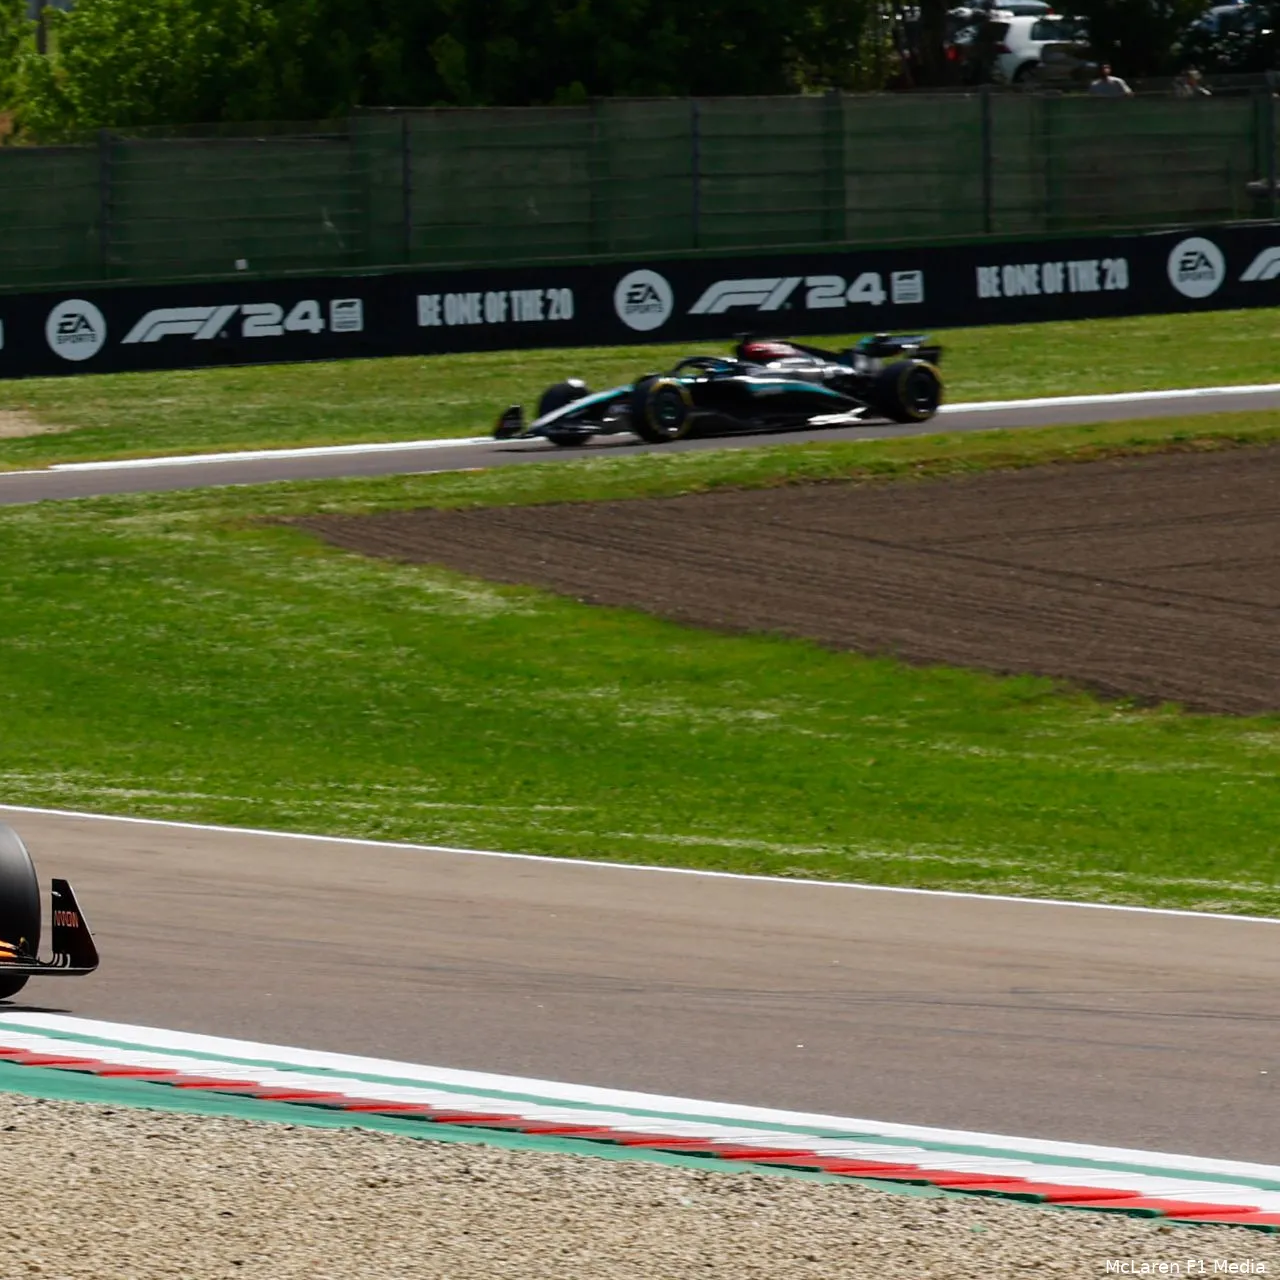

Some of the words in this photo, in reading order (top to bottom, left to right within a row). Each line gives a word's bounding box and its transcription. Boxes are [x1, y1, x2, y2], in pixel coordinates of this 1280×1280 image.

[1179, 251, 1215, 271] EA
[977, 265, 1001, 298] BE
[1002, 263, 1041, 297] ONE
[1042, 261, 1065, 294] OF
[1066, 259, 1101, 293] THE
[1101, 258, 1129, 290] 20
[1177, 271, 1216, 282] SPORTS
[625, 283, 663, 304] EA
[688, 276, 803, 314] F1
[805, 272, 886, 309] 24
[417, 294, 442, 327] BE
[443, 292, 483, 326] ONE
[484, 291, 508, 324] OF
[509, 289, 545, 322] THE
[546, 287, 574, 320] 20
[625, 304, 664, 315] SPORTS
[56, 313, 95, 333] EA
[121, 304, 240, 344] F1
[241, 299, 325, 337] 24
[56, 333, 97, 344] SPORTS
